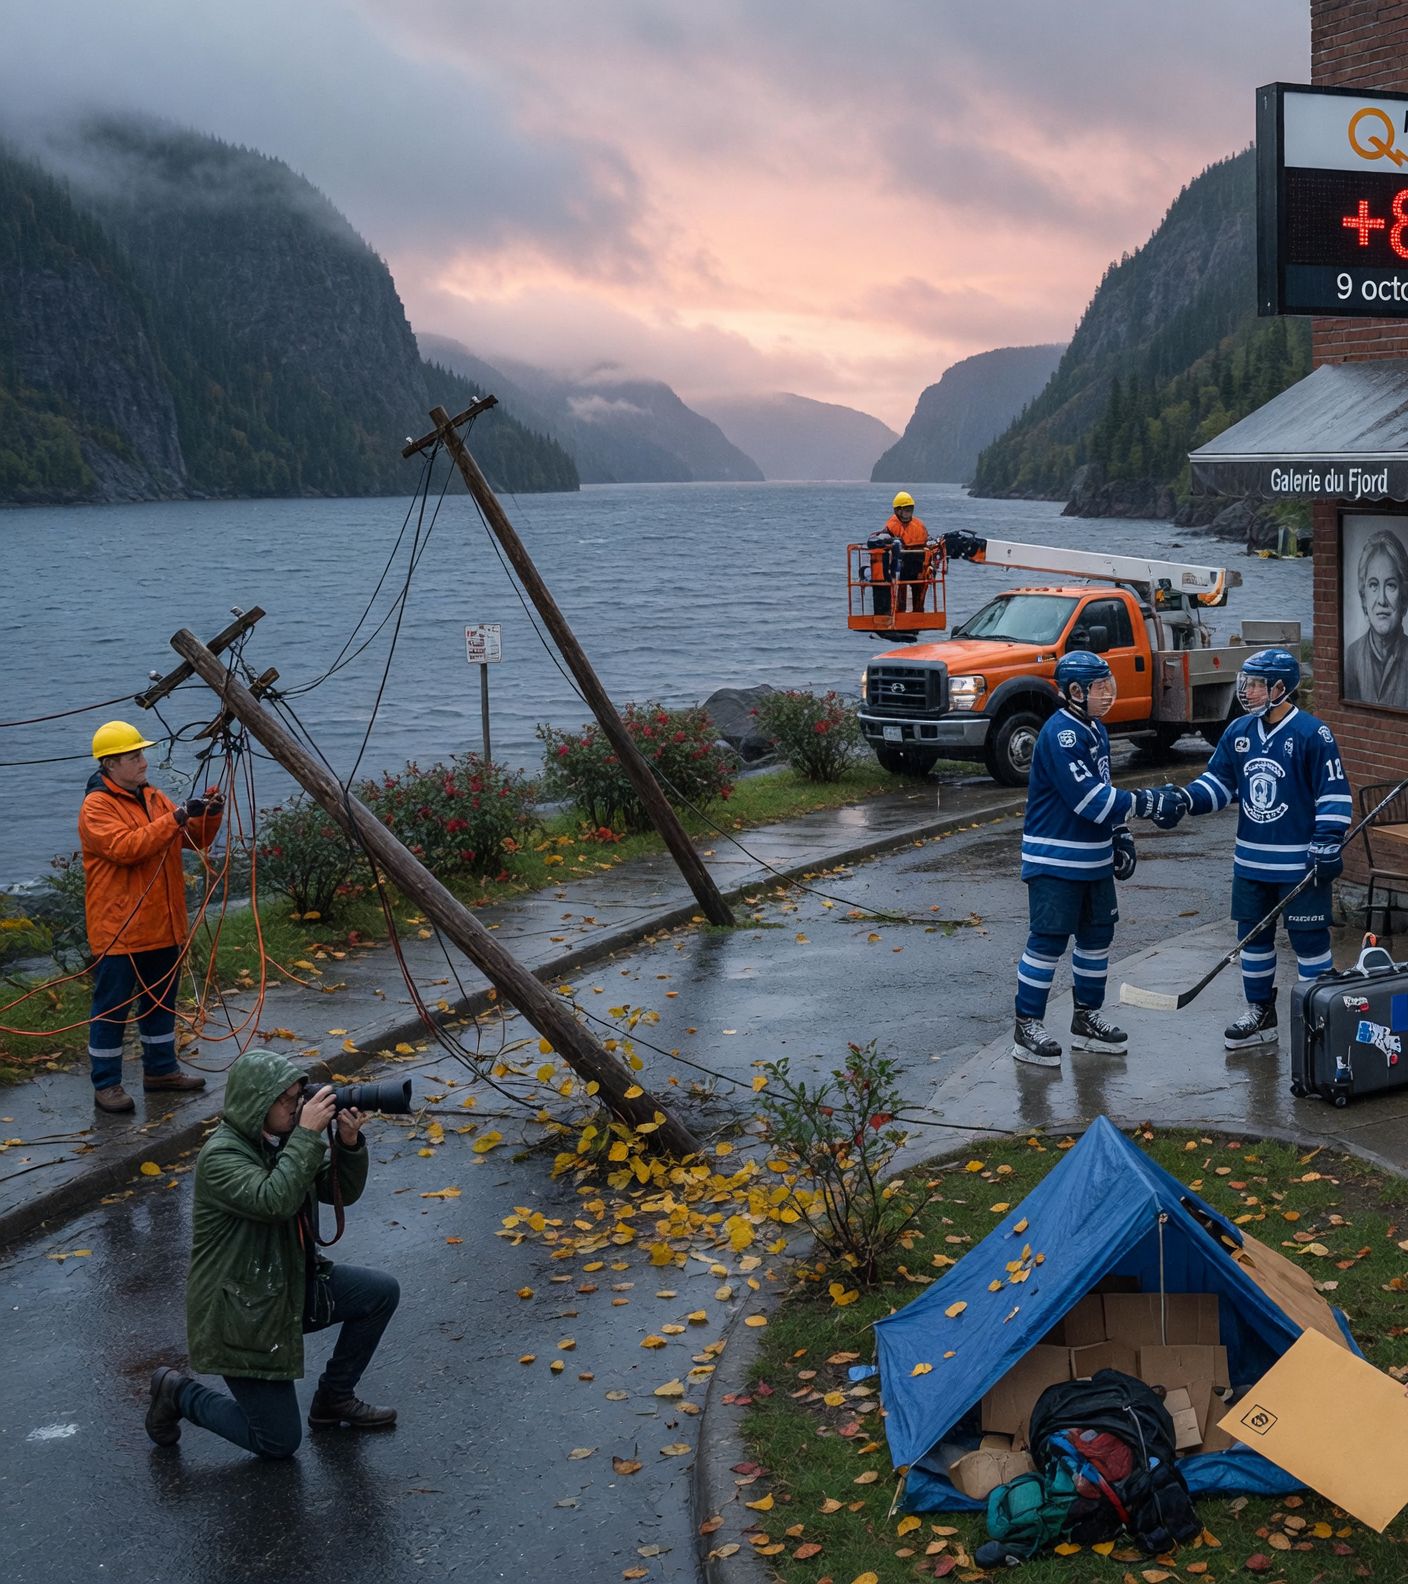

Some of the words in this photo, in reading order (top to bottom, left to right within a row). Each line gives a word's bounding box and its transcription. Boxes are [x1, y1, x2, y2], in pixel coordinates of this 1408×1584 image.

[1336, 272, 1353, 300] 9
[1270, 468, 1321, 492] Galerie
[1324, 468, 1344, 493] du
[1348, 467, 1389, 500] Fjord
